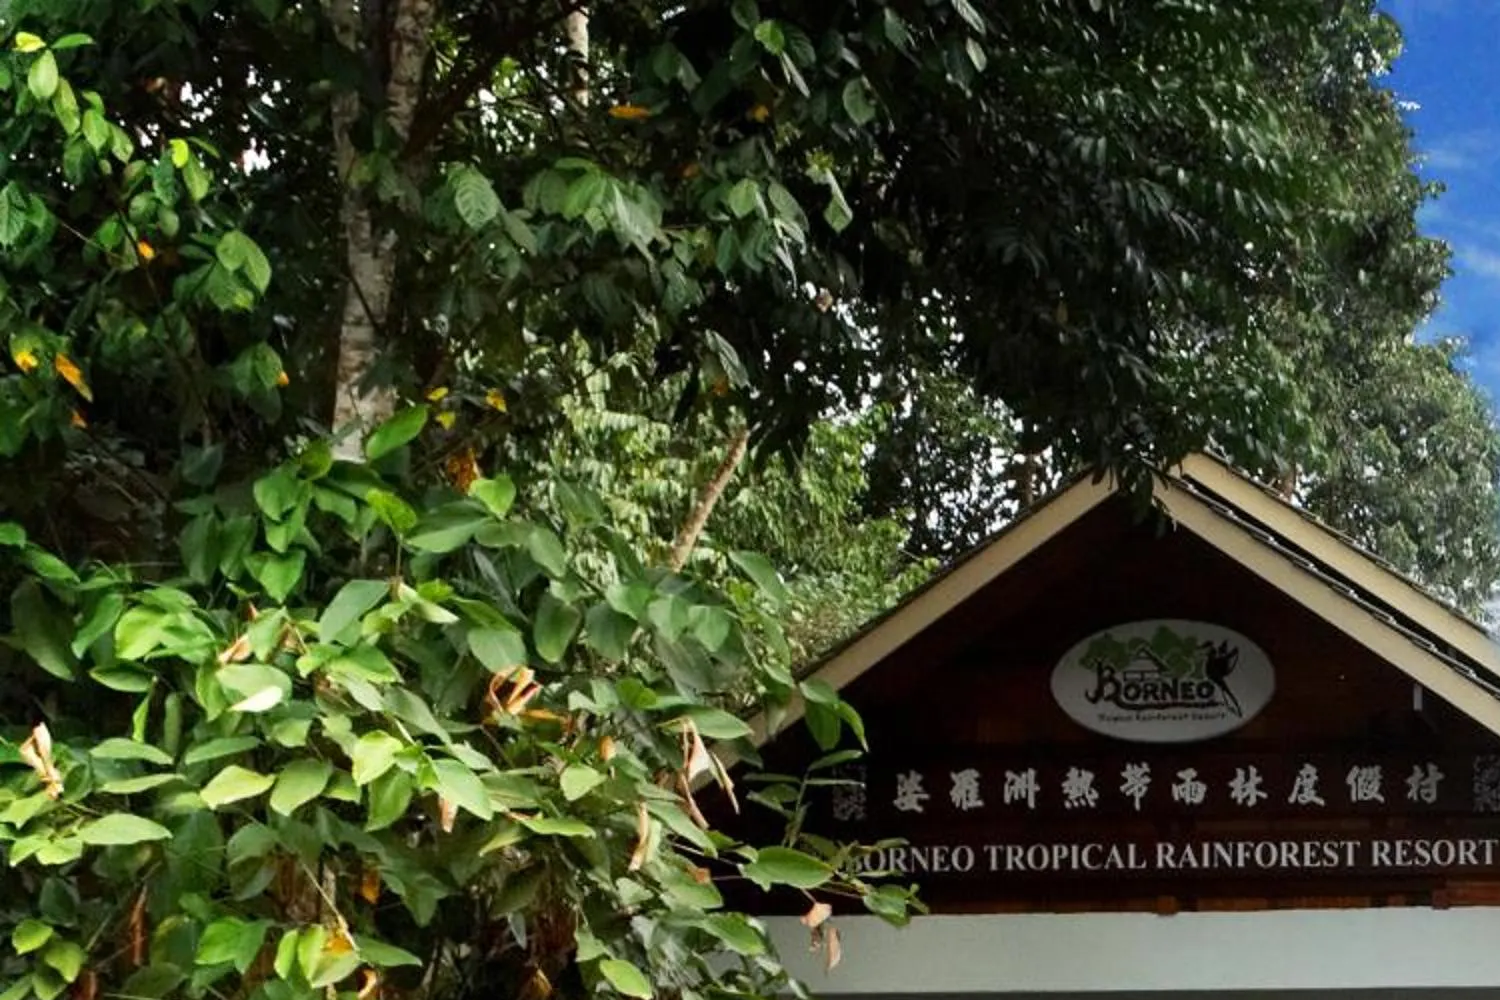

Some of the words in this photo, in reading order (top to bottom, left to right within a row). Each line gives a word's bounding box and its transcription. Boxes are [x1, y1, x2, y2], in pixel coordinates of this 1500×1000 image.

[1085, 659, 1215, 710] BORNEO
[983, 843, 1147, 872] TROPICAL
[1155, 840, 1361, 869] RAINFOREST
[1371, 838, 1499, 867] RESORT
